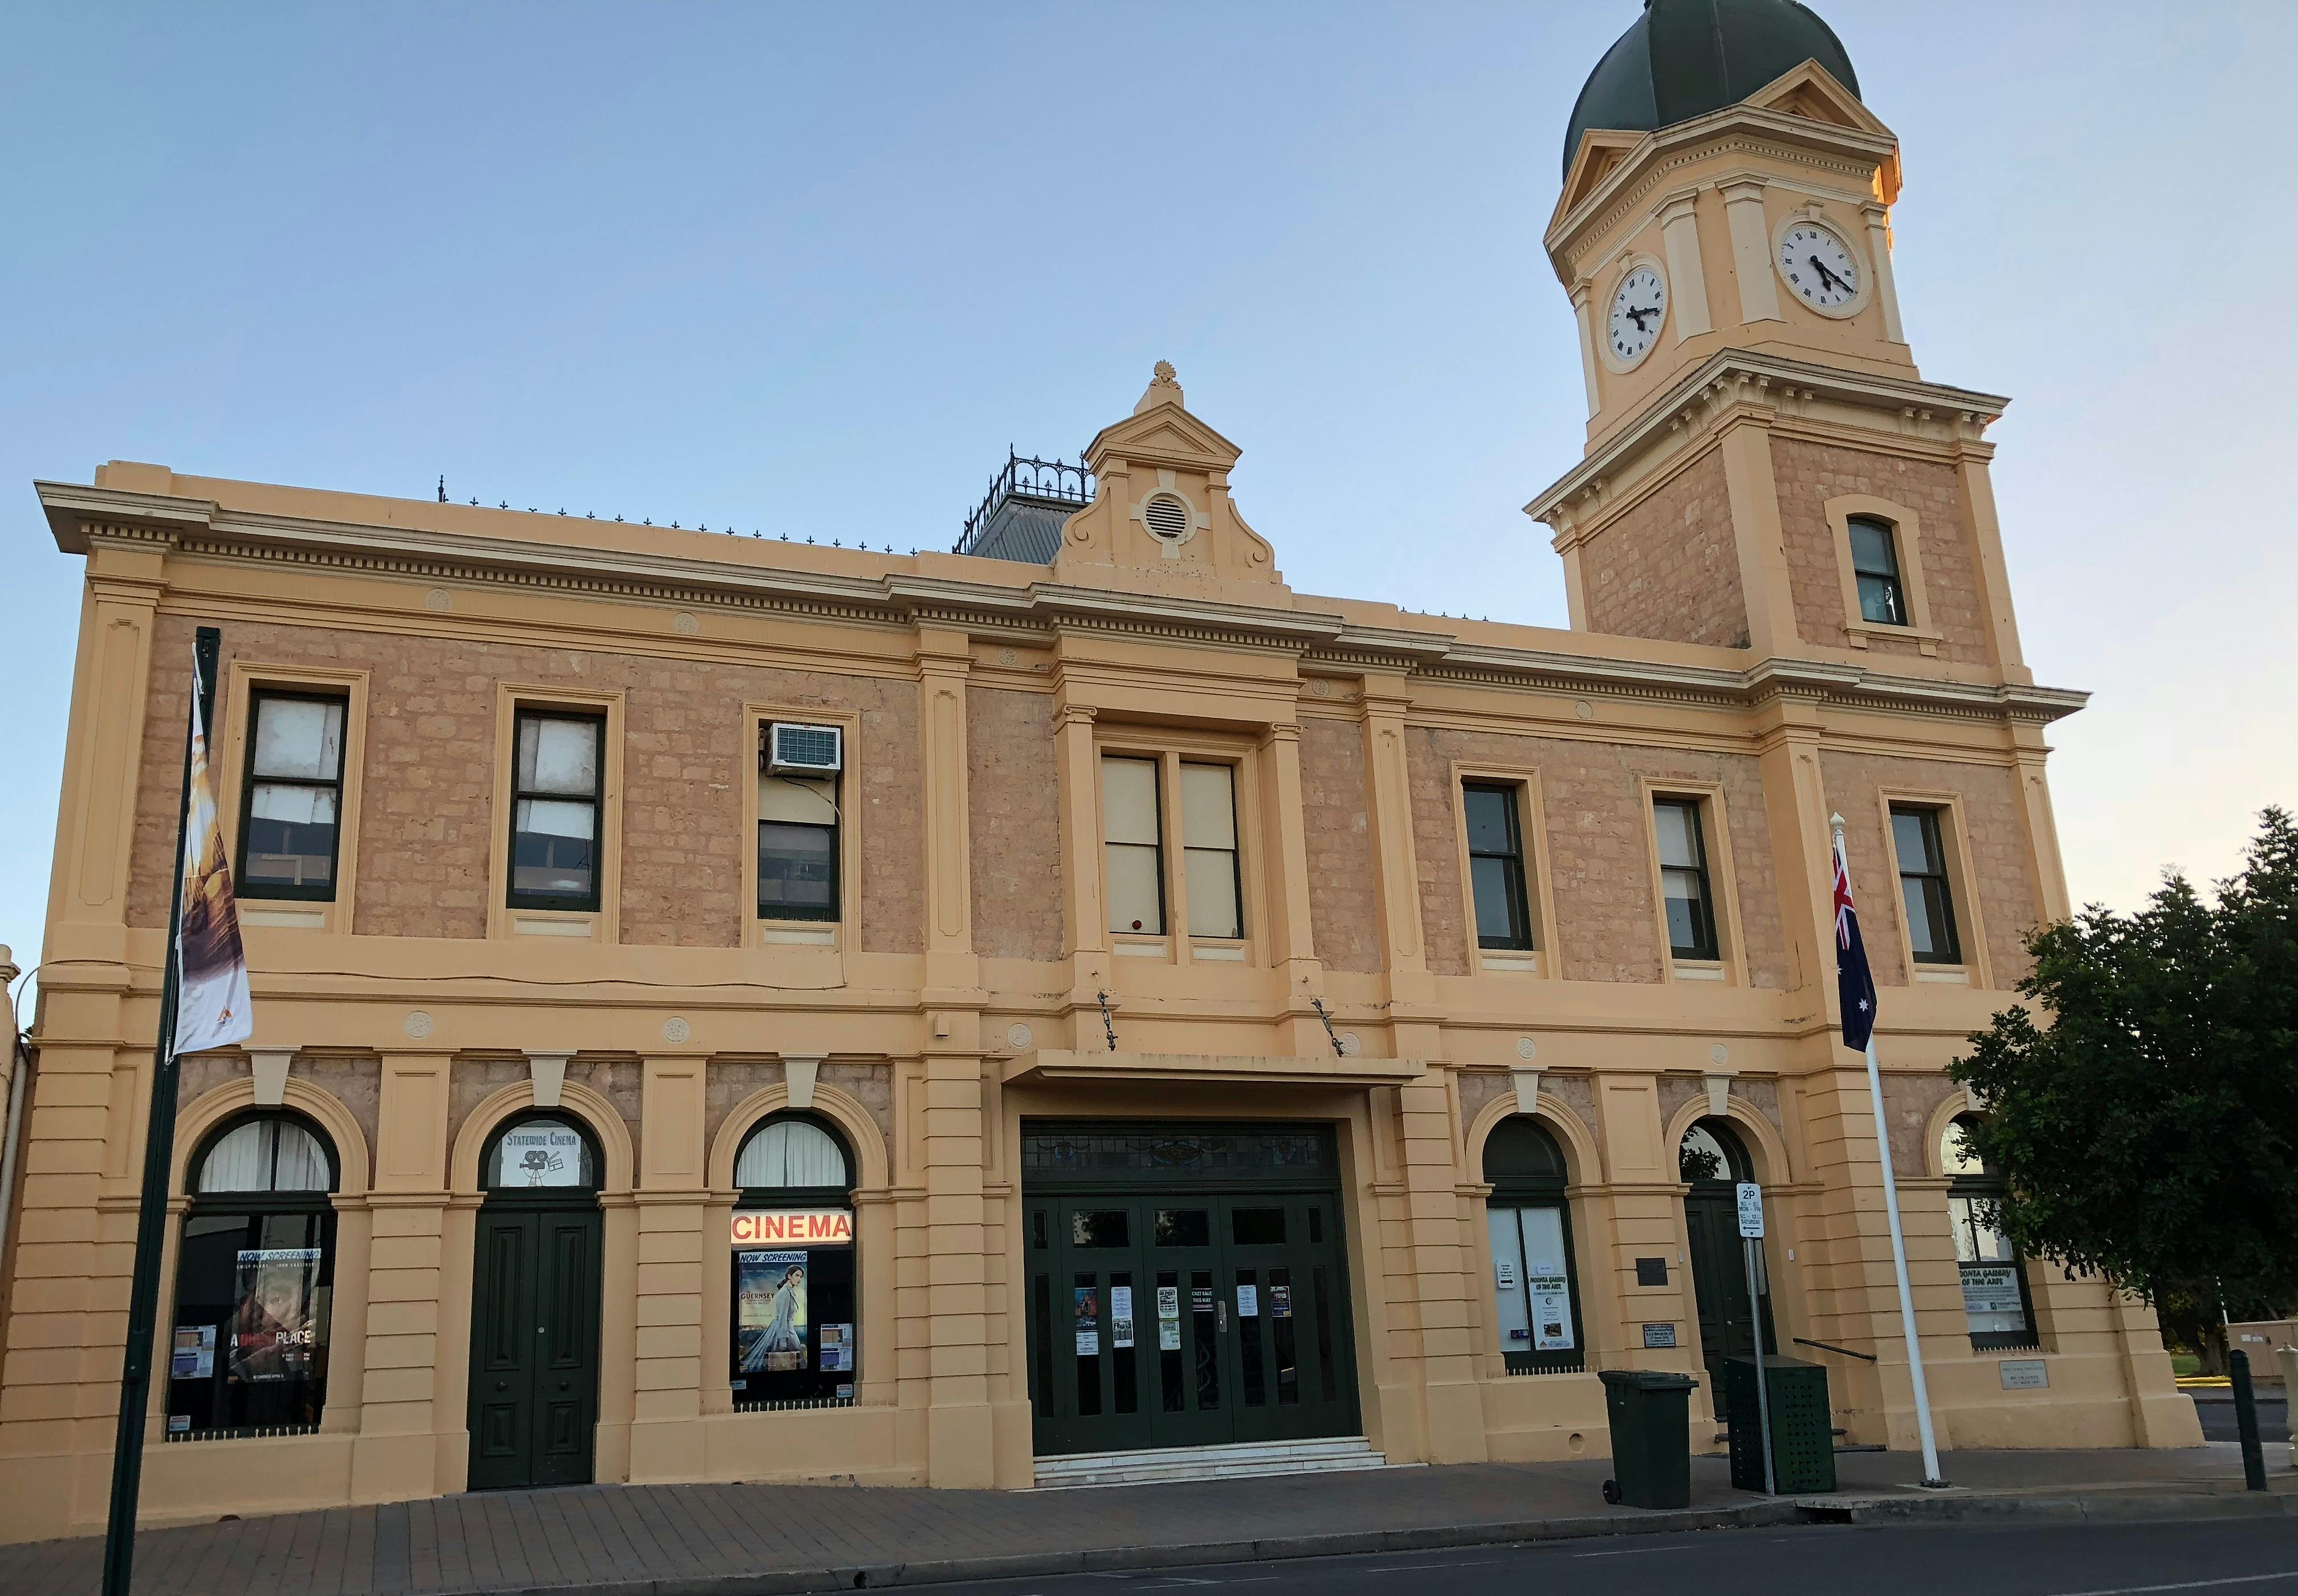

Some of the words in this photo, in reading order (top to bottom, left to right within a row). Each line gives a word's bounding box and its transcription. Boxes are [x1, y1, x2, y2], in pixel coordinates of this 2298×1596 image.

[507, 1132, 547, 1146] STATEWIDE
[550, 1131, 576, 1146] CINEMA
[1743, 1190, 1755, 1199] 2P
[732, 1215, 850, 1239] CINEMA
[239, 1251, 264, 1261] NOW
[266, 1250, 320, 1260] SCREENING
[741, 1254, 761, 1262] NOW
[762, 1252, 807, 1262] SCREENING
[1983, 1270, 2011, 1278] GALLERY
[230, 1333, 238, 1347] A
[275, 1330, 311, 1344] PLACE
